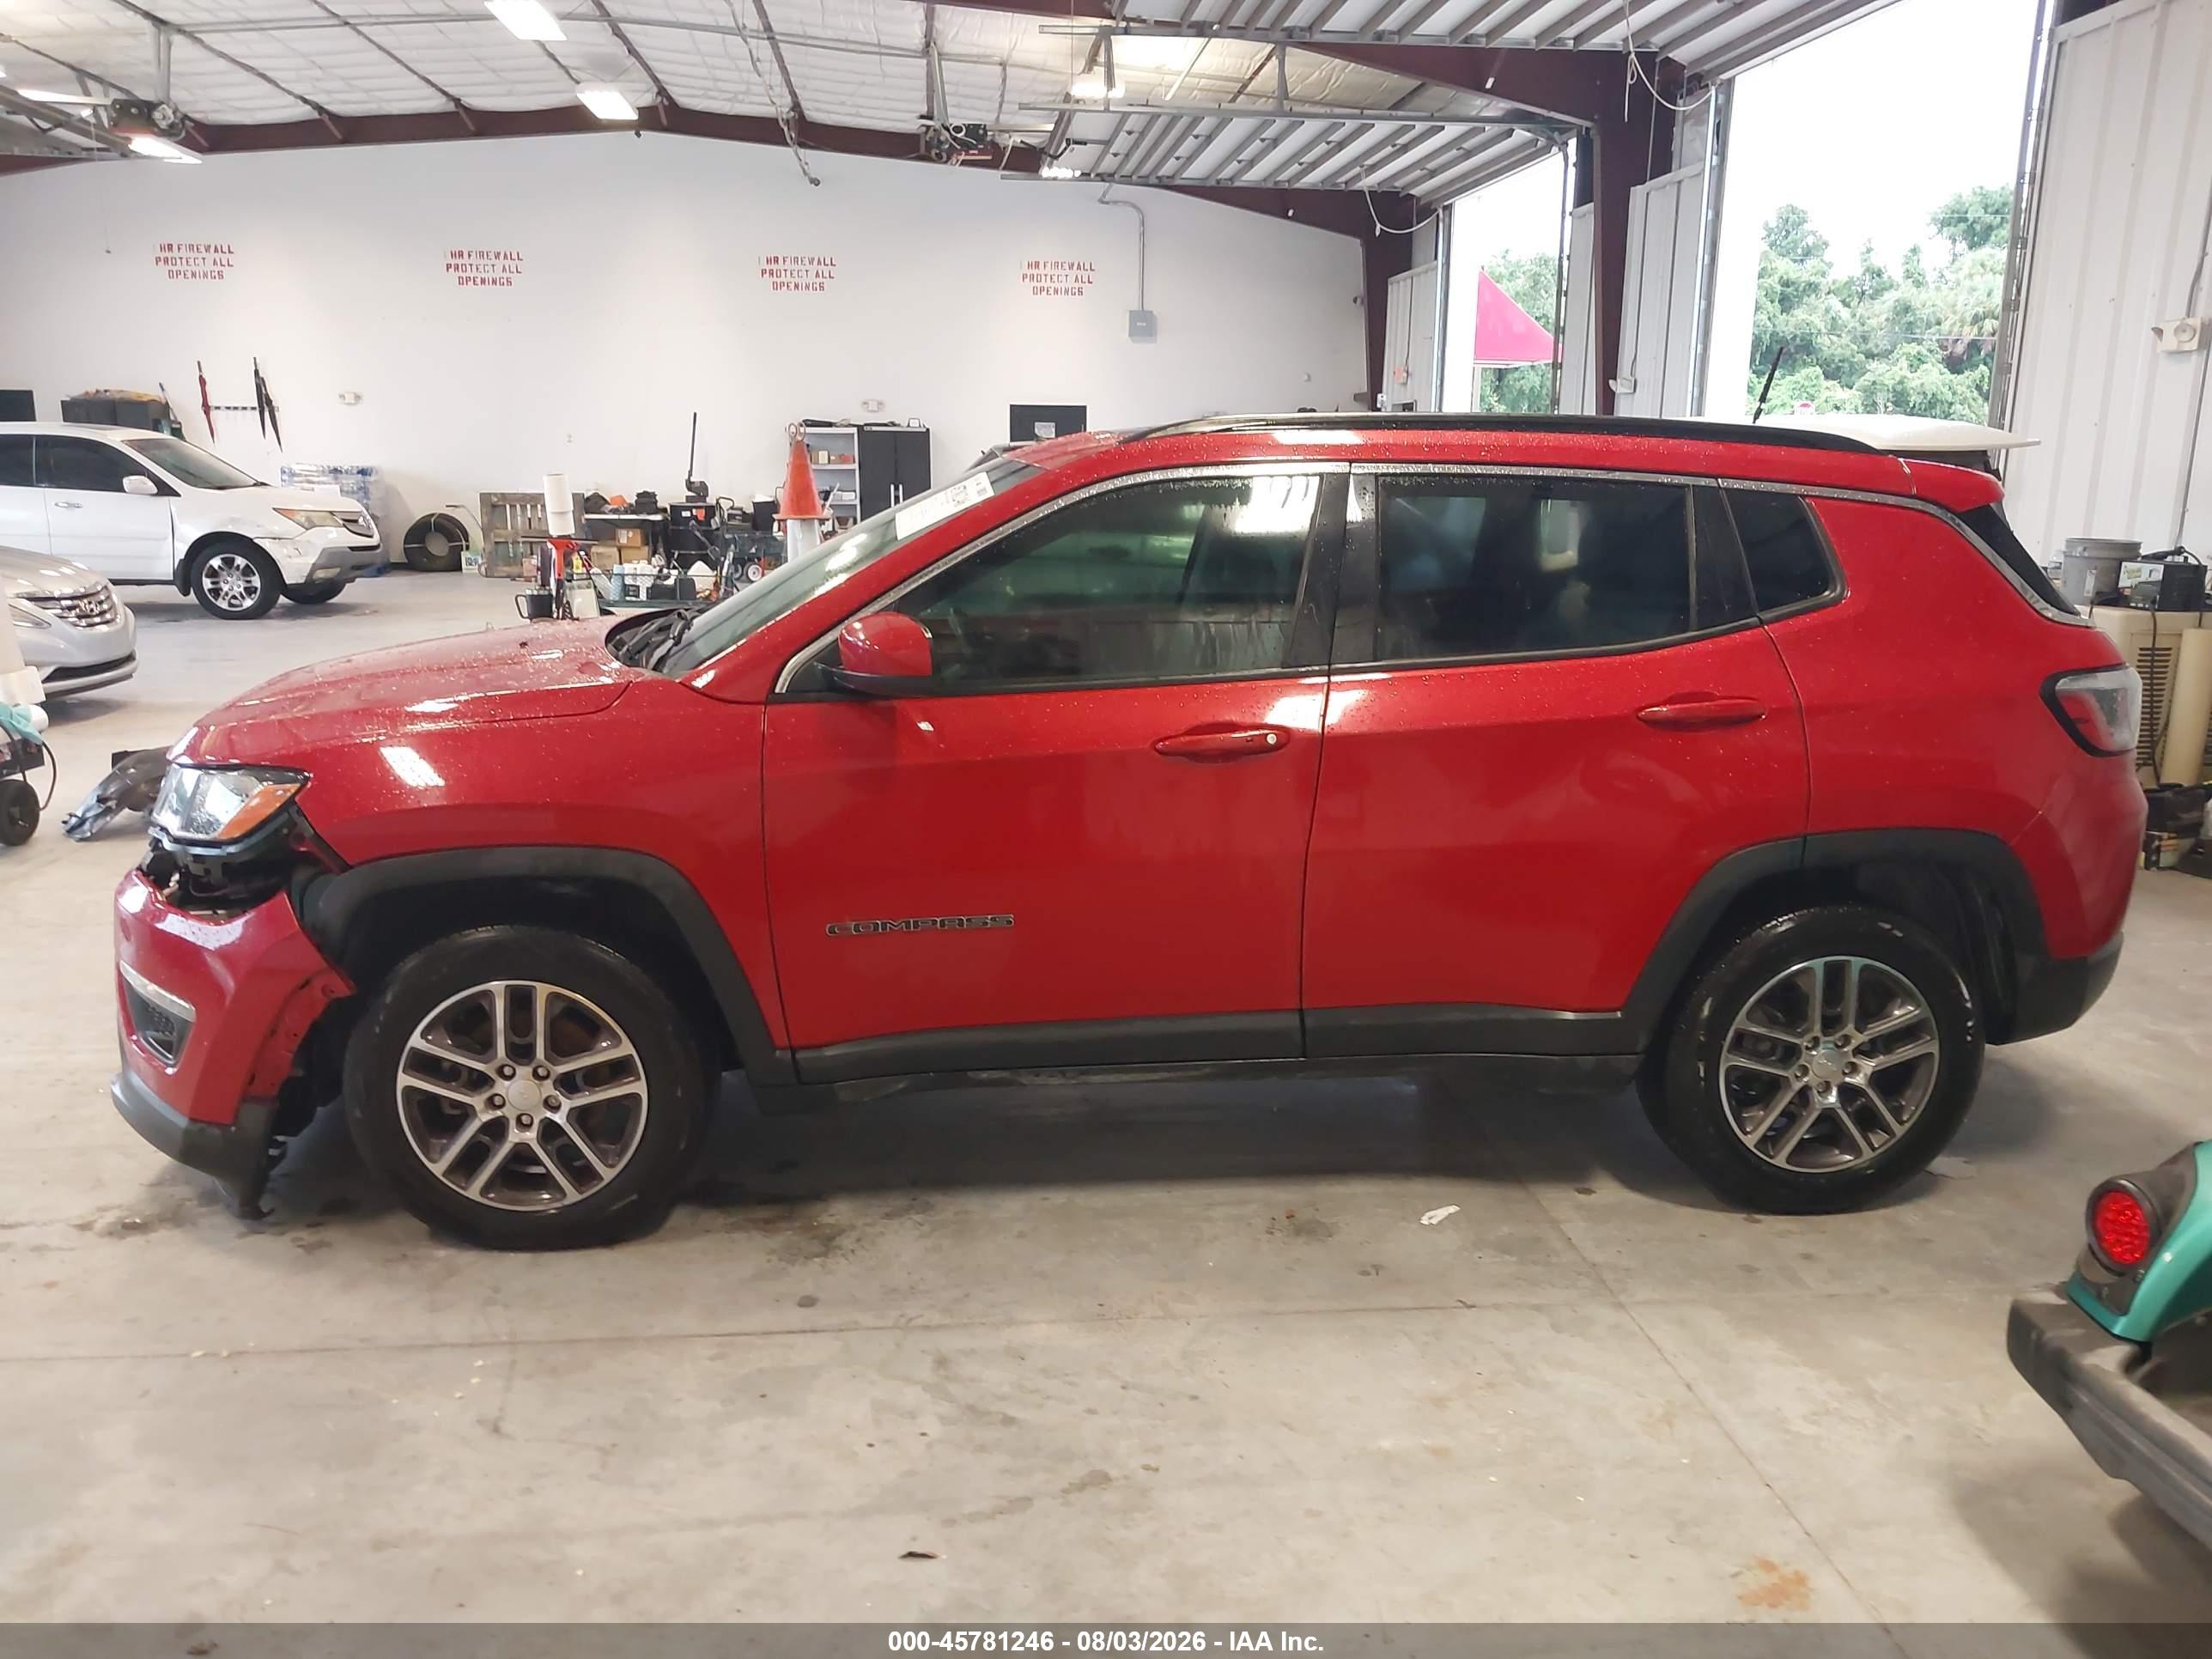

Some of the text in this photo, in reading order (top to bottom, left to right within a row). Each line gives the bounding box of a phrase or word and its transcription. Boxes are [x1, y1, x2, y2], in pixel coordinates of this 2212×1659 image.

[177, 244, 234, 254] FIREWALL
[467, 251, 524, 261] FIREWALL
[766, 256, 780, 265] HR
[782, 256, 836, 267] FIREWALL
[155, 256, 234, 268] PROTECT ALL
[1043, 261, 1096, 271] FIREWALL
[446, 263, 522, 274] PROTECT ALL
[761, 268, 835, 279] PROTECT ALL
[167, 269, 224, 280] OPENINGS
[1022, 273, 1093, 284] PROTECT ALL
[458, 276, 513, 287] OPENINGS
[772, 281, 825, 292] OPENINGS
[1032, 286, 1084, 296] OPENINGS
[826, 914, 1015, 936] COMPASS
